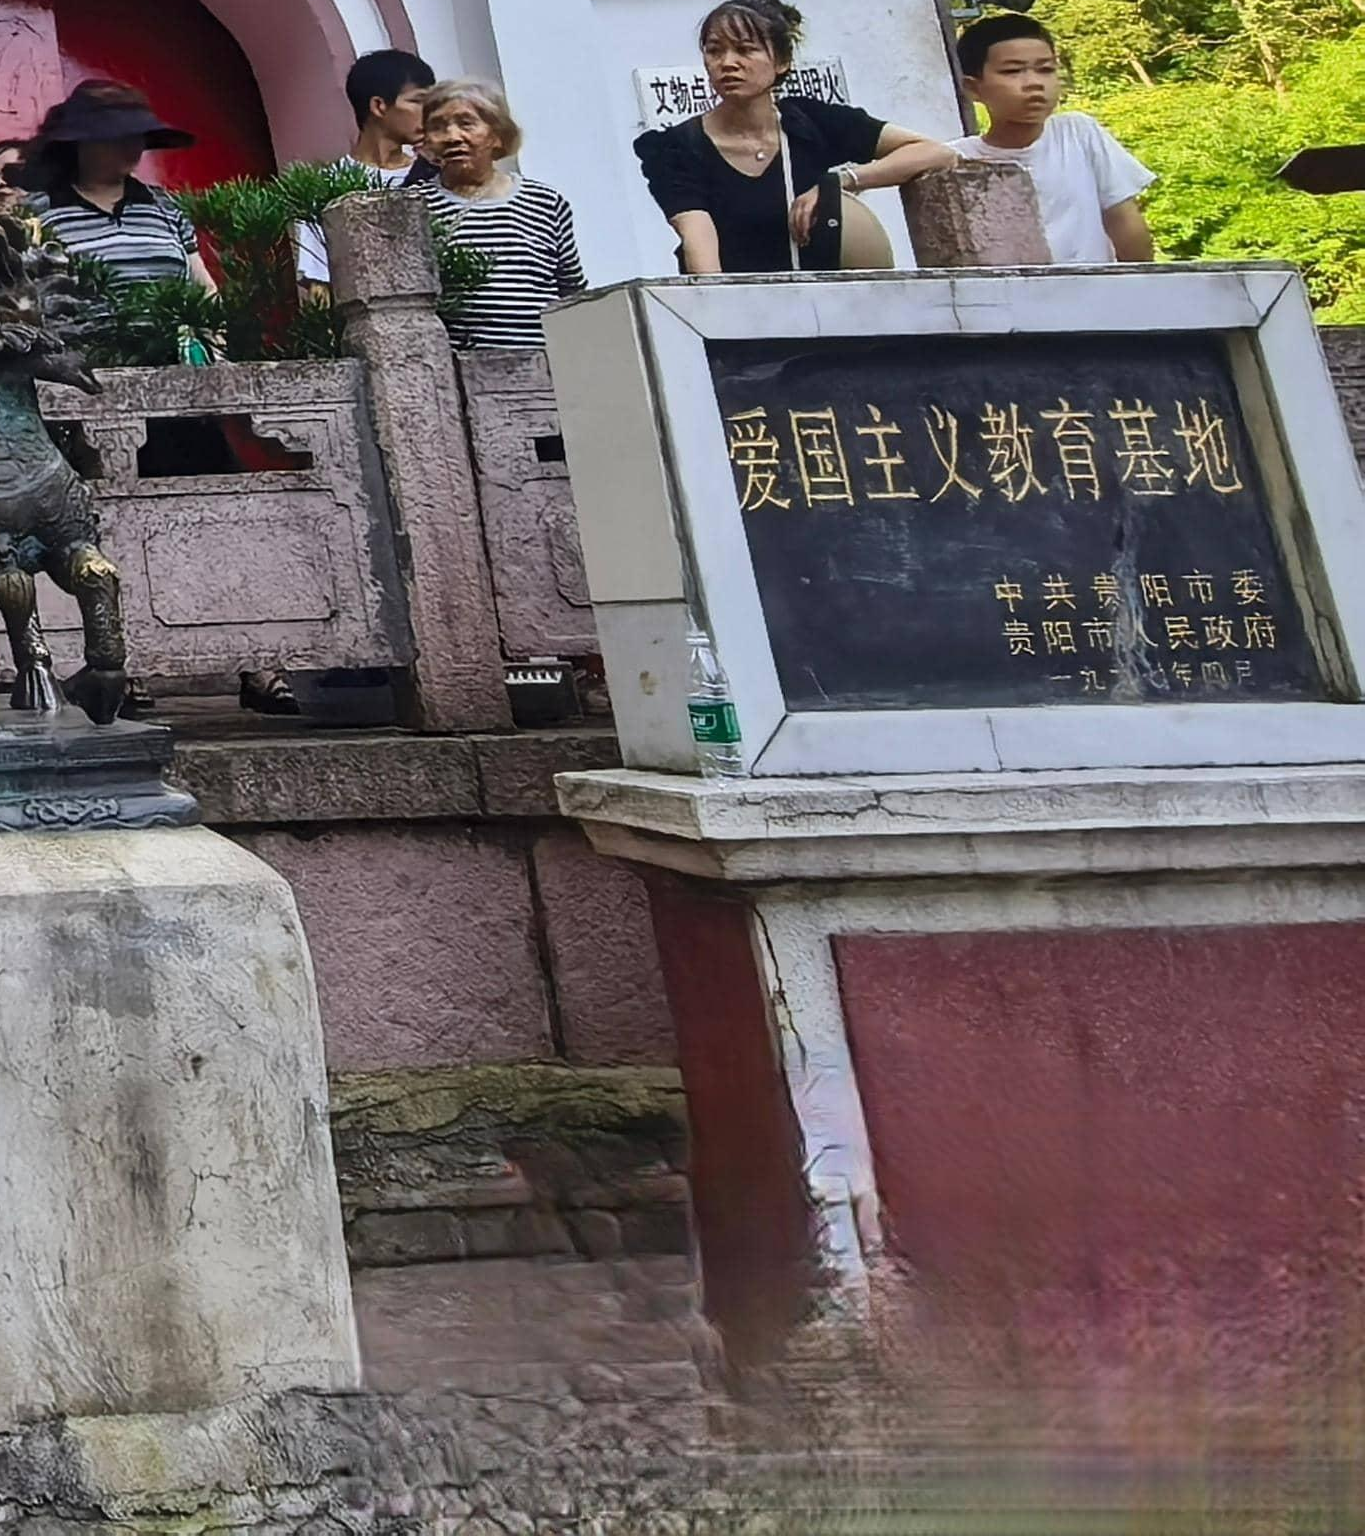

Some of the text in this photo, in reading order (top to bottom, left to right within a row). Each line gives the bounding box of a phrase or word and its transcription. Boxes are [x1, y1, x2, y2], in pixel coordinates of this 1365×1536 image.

[649, 72, 724, 114] 文物点
[725, 397, 1244, 512] 爱国主义教育基地
[993, 567, 1267, 614] 中共贵阳市委
[1000, 610, 1278, 656] 贵阳市人民政府
